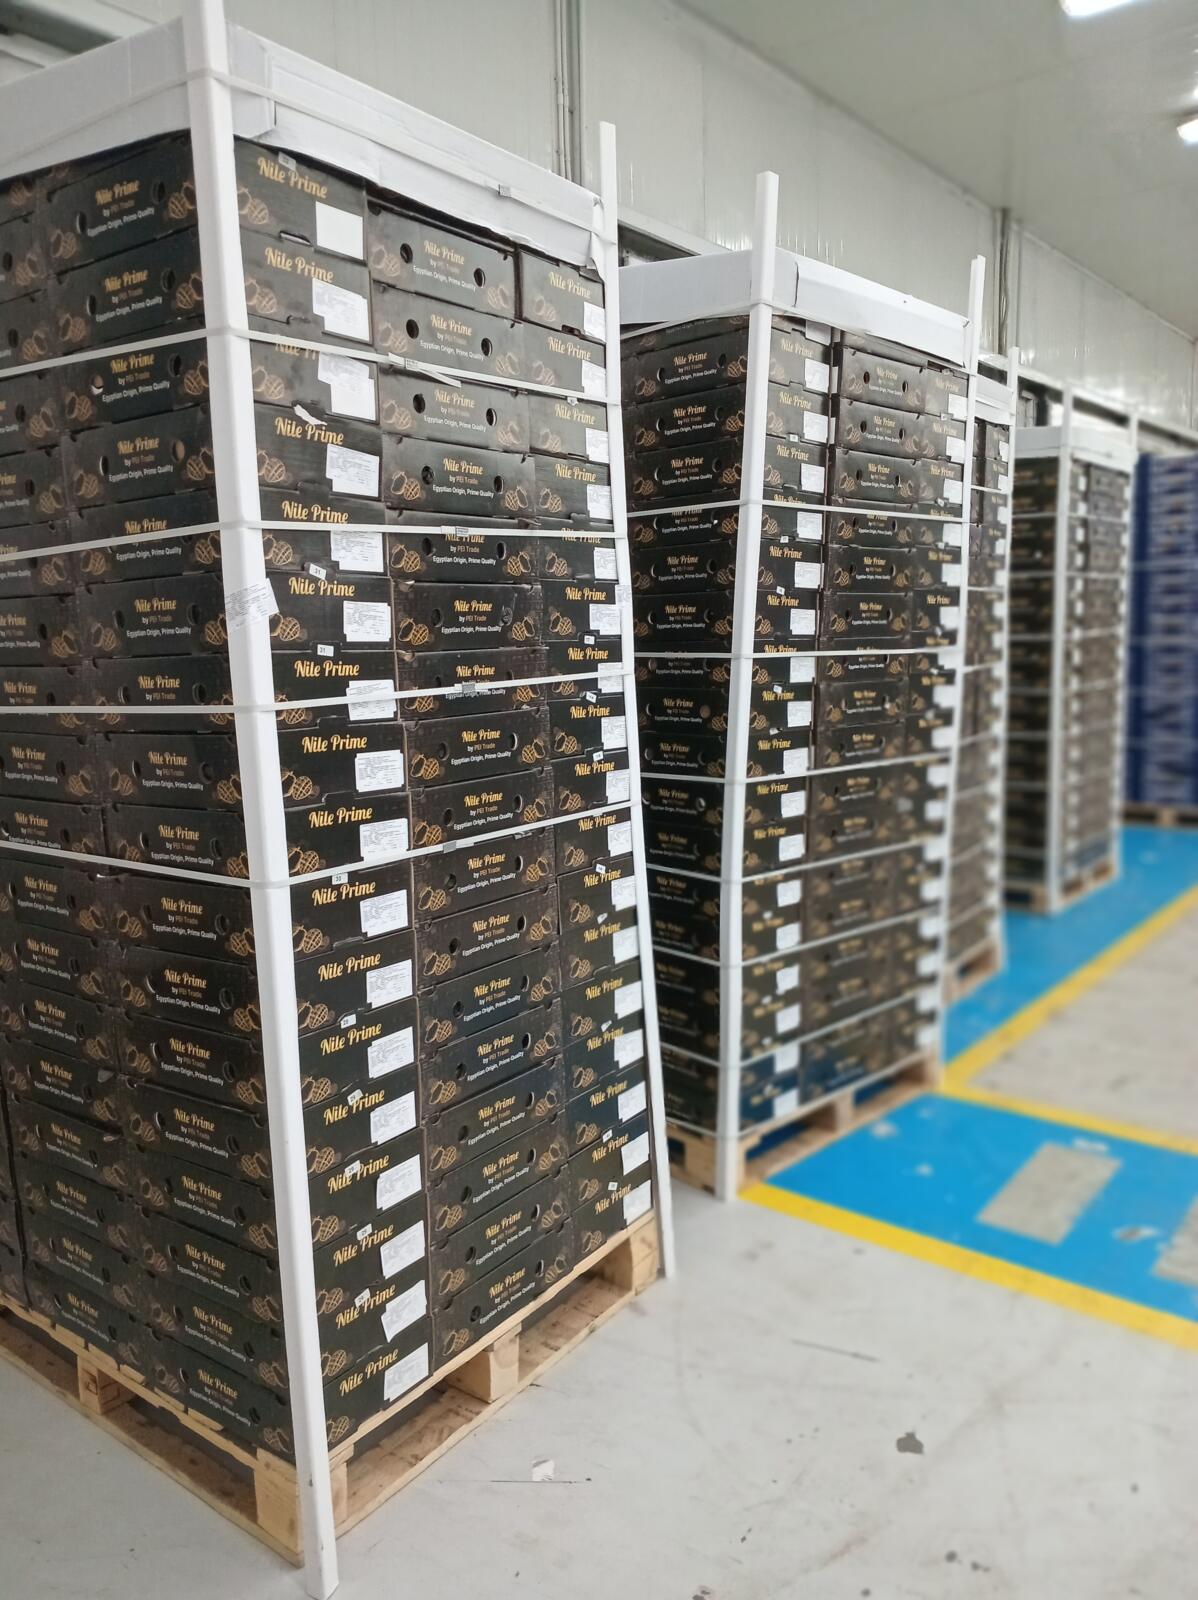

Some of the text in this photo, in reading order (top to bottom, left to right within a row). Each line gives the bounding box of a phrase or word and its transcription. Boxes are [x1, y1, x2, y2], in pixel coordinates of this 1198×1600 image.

[258, 157, 327, 199] Nile Prime
[96, 180, 140, 205] Nile Prime
[265, 247, 334, 284] Nile Prime
[105, 270, 148, 292] Nile Prime
[549, 272, 590, 298] Nile Prime
[431, 314, 472, 336] Nile Prime
[549, 336, 591, 360] Nile Prime
[781, 339, 813, 357] Nile Prime
[110, 353, 154, 374] Nile Prime
[674, 352, 707, 366] Nile Prime
[435, 389, 475, 408] Nile Prime
[555, 403, 595, 425] Nile Prime
[673, 404, 706, 418] Nile Prime
[275, 417, 344, 445] Nile Prime
[777, 445, 808, 461] Nile Prime
[444, 458, 483, 474] Nile Prime
[555, 463, 596, 482] Nile Prime
[282, 500, 348, 523] Nile Prime
[770, 545, 802, 559] Nile Prime
[289, 577, 355, 596] Nile Prime
[565, 587, 606, 600] Nile Prime
[135, 598, 177, 613] Nile Prime
[454, 600, 492, 612] Nile Prime
[767, 595, 799, 606] Nile Prime
[442, 626, 460, 634] Egyptian
[568, 647, 608, 660] Nile Prime
[294, 660, 360, 677] Nile Prime
[456, 665, 495, 677] Nile Prime
[570, 705, 610, 719] Nile Prime
[302, 734, 368, 753] Nile Prime
[462, 729, 500, 742] Nile Prime
[758, 738, 791, 750] Nile Prime
[148, 751, 188, 765] Nile Prime
[575, 761, 615, 776] Nile Prime
[464, 792, 503, 807] Nile Prime
[309, 807, 373, 828] Nile Prime
[454, 822, 472, 830] Egyptian
[579, 814, 616, 832] Nile Prime
[159, 825, 199, 840] Nile Prime
[468, 853, 505, 870] Nile Prime
[584, 874, 598, 888] Nile
[312, 881, 376, 906] Nile Prime
[161, 897, 203, 915] Nile Prime
[473, 914, 510, 933] Nile Prime
[584, 922, 621, 943] Nile Prime
[318, 953, 381, 982] Nile Prime
[164, 969, 207, 989] Nile Prime
[474, 977, 511, 998] Nile Prime
[586, 978, 623, 1000] Nile Prime
[320, 1023, 382, 1056] Nile Prime
[477, 1034, 514, 1056] Nile Prime
[587, 1027, 624, 1051] Nile Prime
[590, 1081, 627, 1107] Nile Prime
[324, 1106, 349, 1125] Nile
[479, 1096, 515, 1120] Nile Prime
[174, 1108, 215, 1132] Nile Prime
[592, 1134, 629, 1163] Nile Prime
[328, 1155, 389, 1194] Nile Prime
[483, 1152, 519, 1178] Nile Prime
[595, 1184, 631, 1214] Nile Prime
[333, 1224, 394, 1267] Nile Prime
[489, 1268, 525, 1298] Nile Prime
[336, 1284, 395, 1329] Nile Prime
[339, 1349, 398, 1397] Nile Prime
